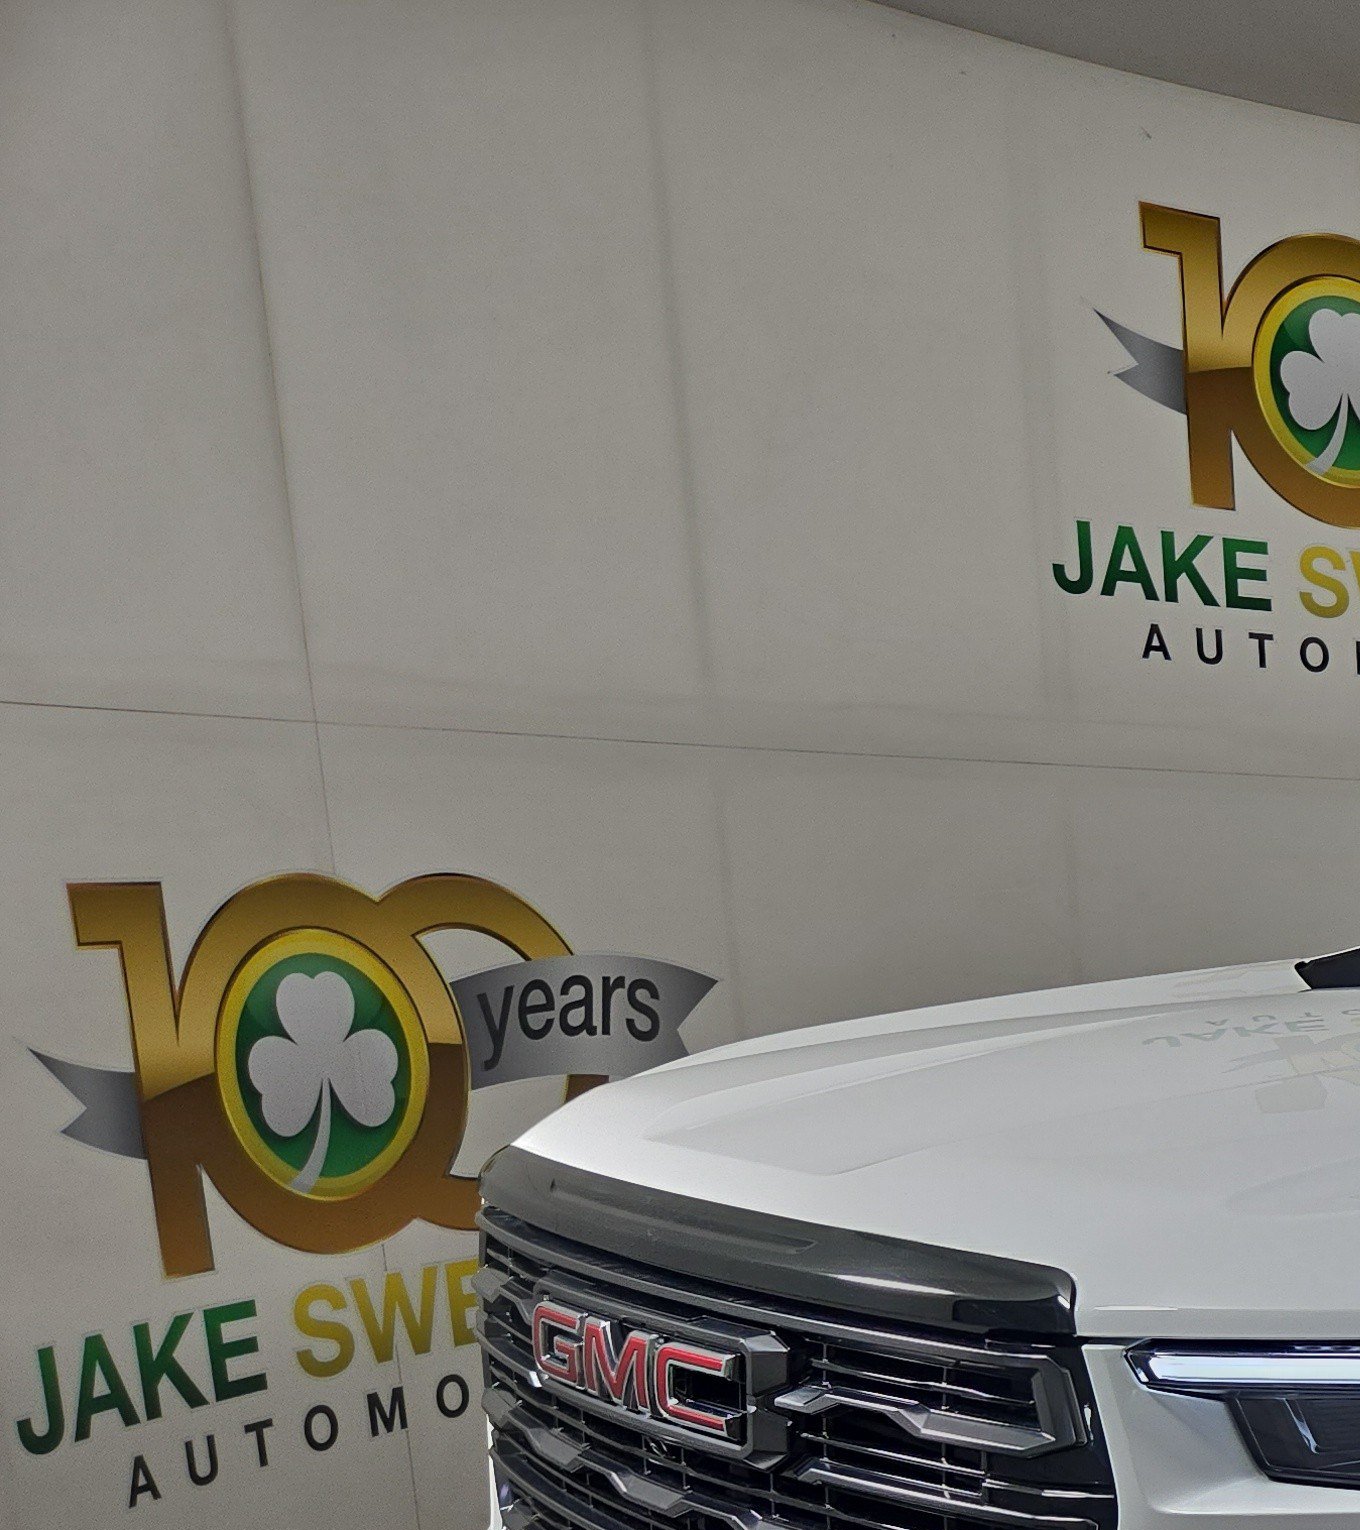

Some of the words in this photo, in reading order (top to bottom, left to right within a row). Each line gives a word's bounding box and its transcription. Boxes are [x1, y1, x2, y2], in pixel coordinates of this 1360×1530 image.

[1052, 520, 1274, 612] JAKE
[476, 973, 661, 1072] years
[15, 1299, 269, 1456] JAKE
[531, 1300, 740, 1438] GMC
[127, 1373, 471, 1509] AUTOMO
